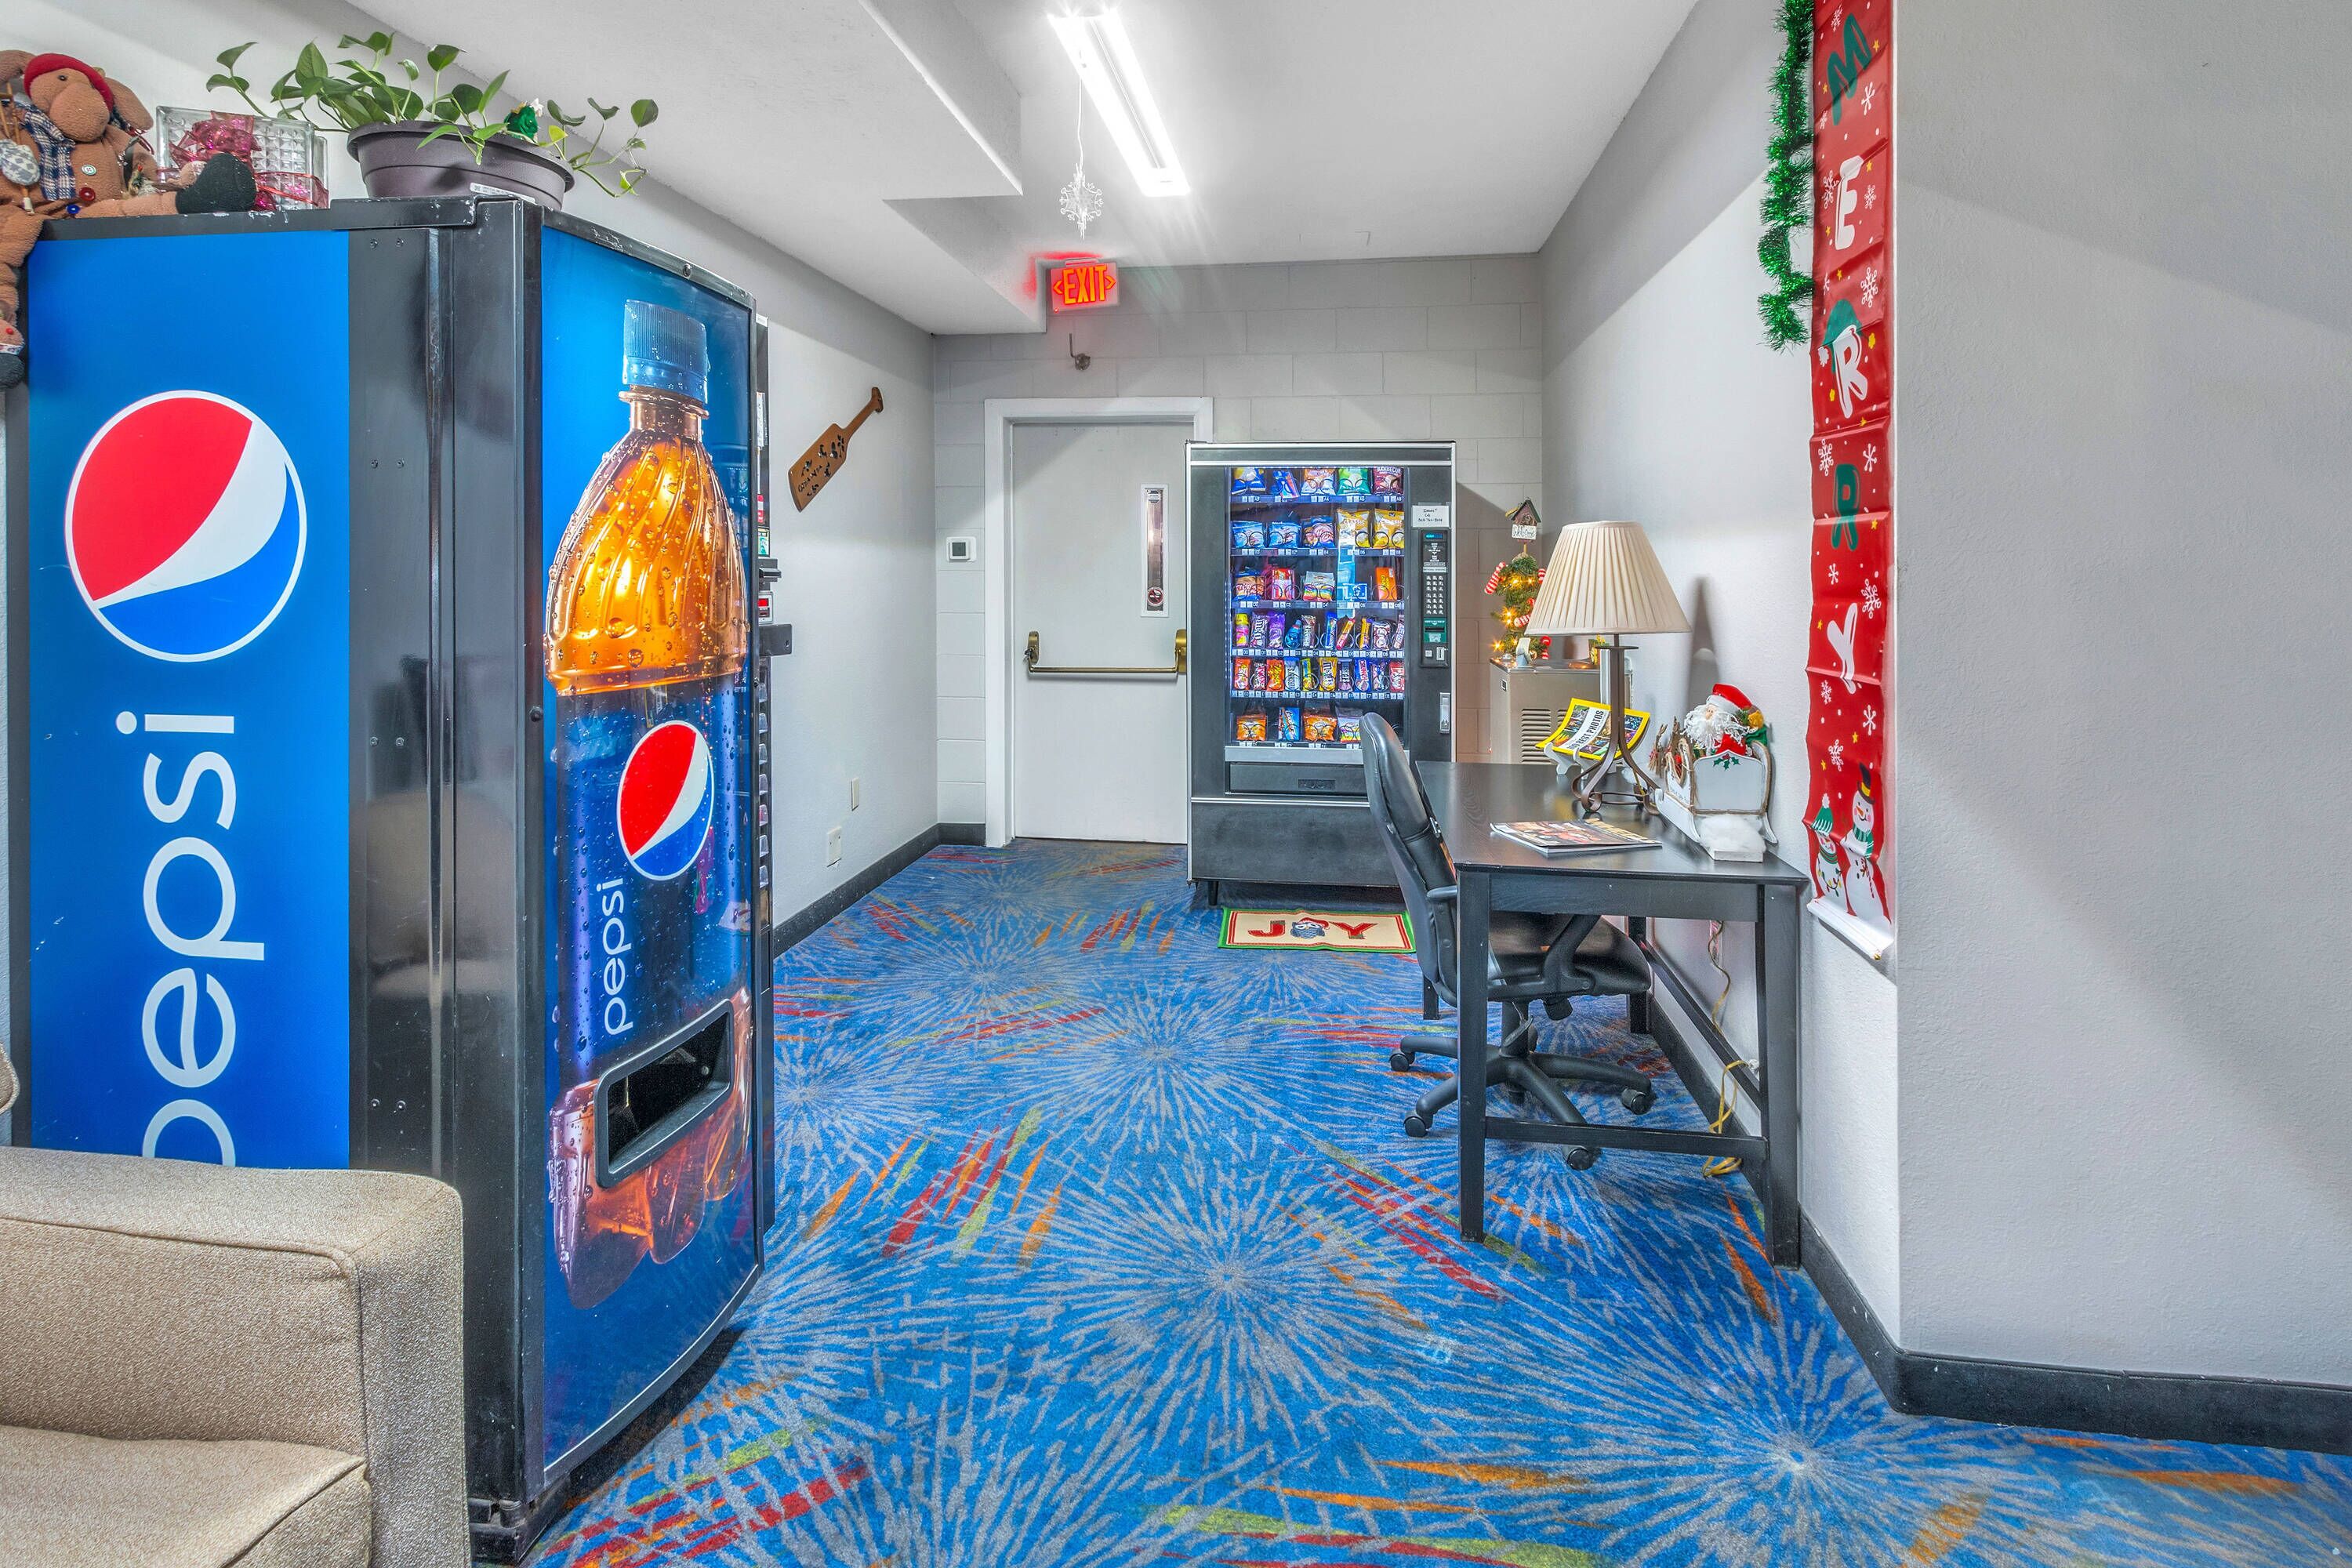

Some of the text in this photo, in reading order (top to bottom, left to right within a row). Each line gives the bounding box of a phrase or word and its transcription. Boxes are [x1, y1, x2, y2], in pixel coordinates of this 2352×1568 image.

[1062, 263, 1107, 305] EXIT
[1588, 710, 1604, 735] PHOTOS
[597, 877, 633, 1036] pepsi
